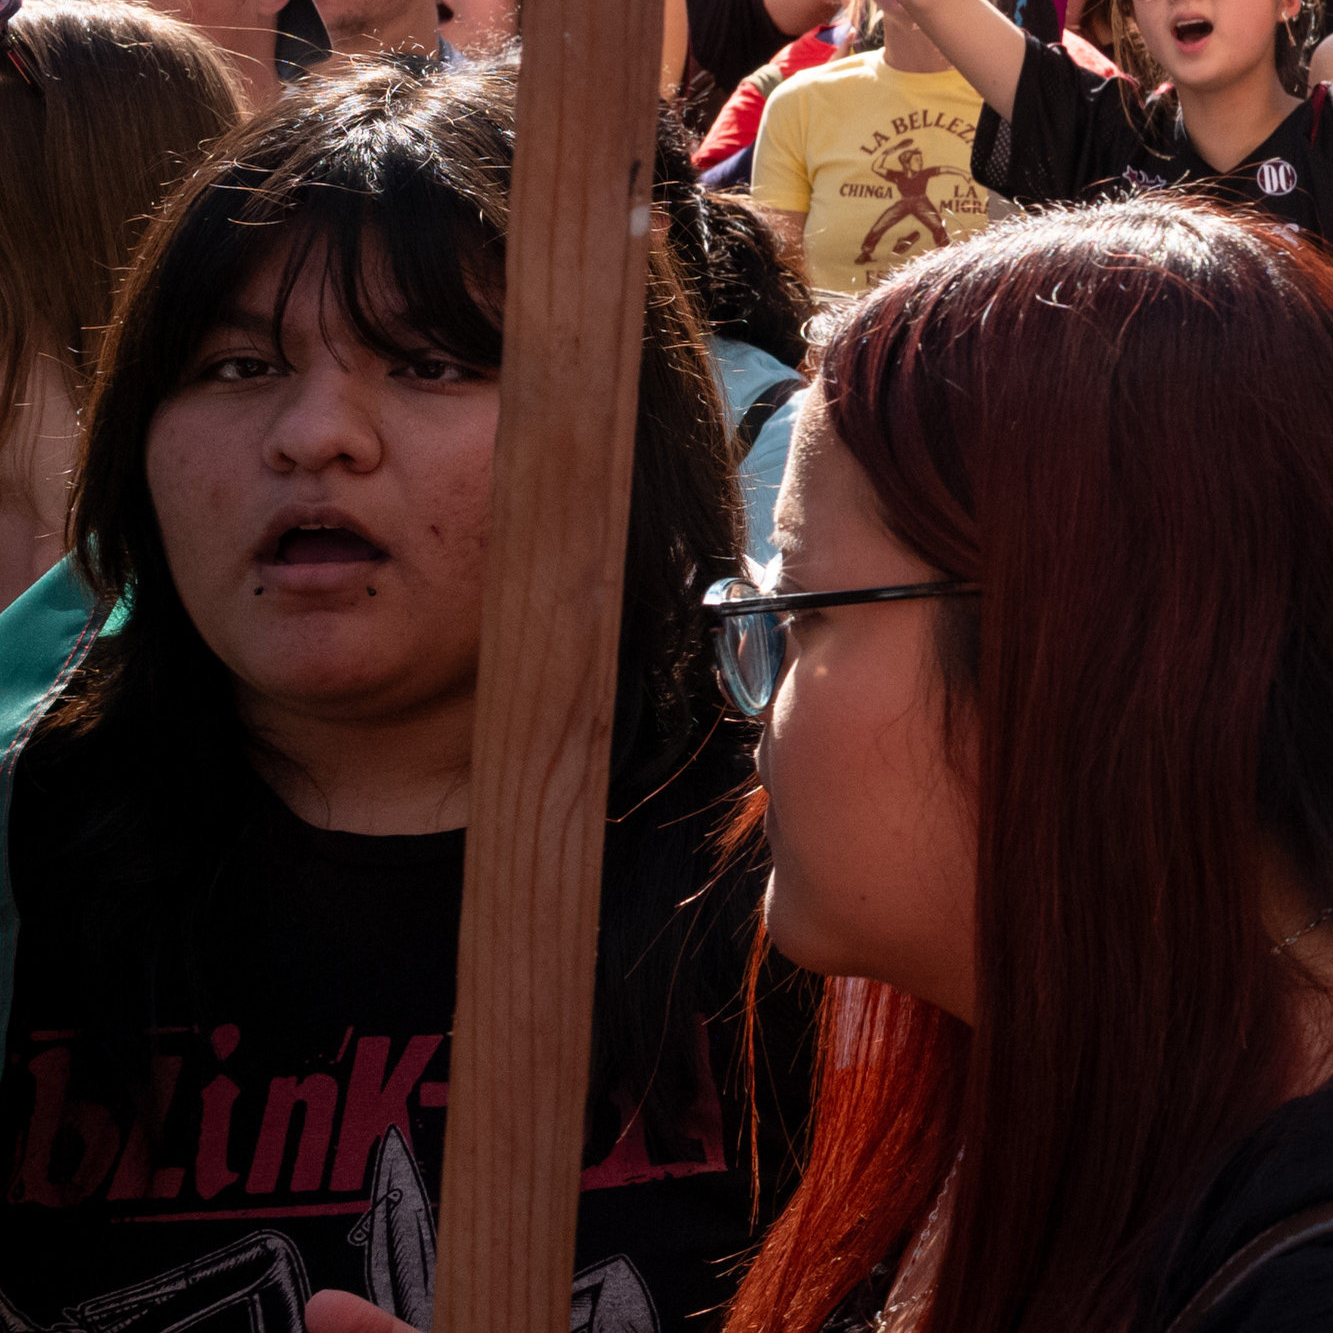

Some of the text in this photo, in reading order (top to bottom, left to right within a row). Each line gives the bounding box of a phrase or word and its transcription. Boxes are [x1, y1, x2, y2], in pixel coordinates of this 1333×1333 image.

[860, 108, 977, 156] LA BELLEZ
[839, 182, 894, 200] CHINGA
[954, 184, 978, 198] LA
